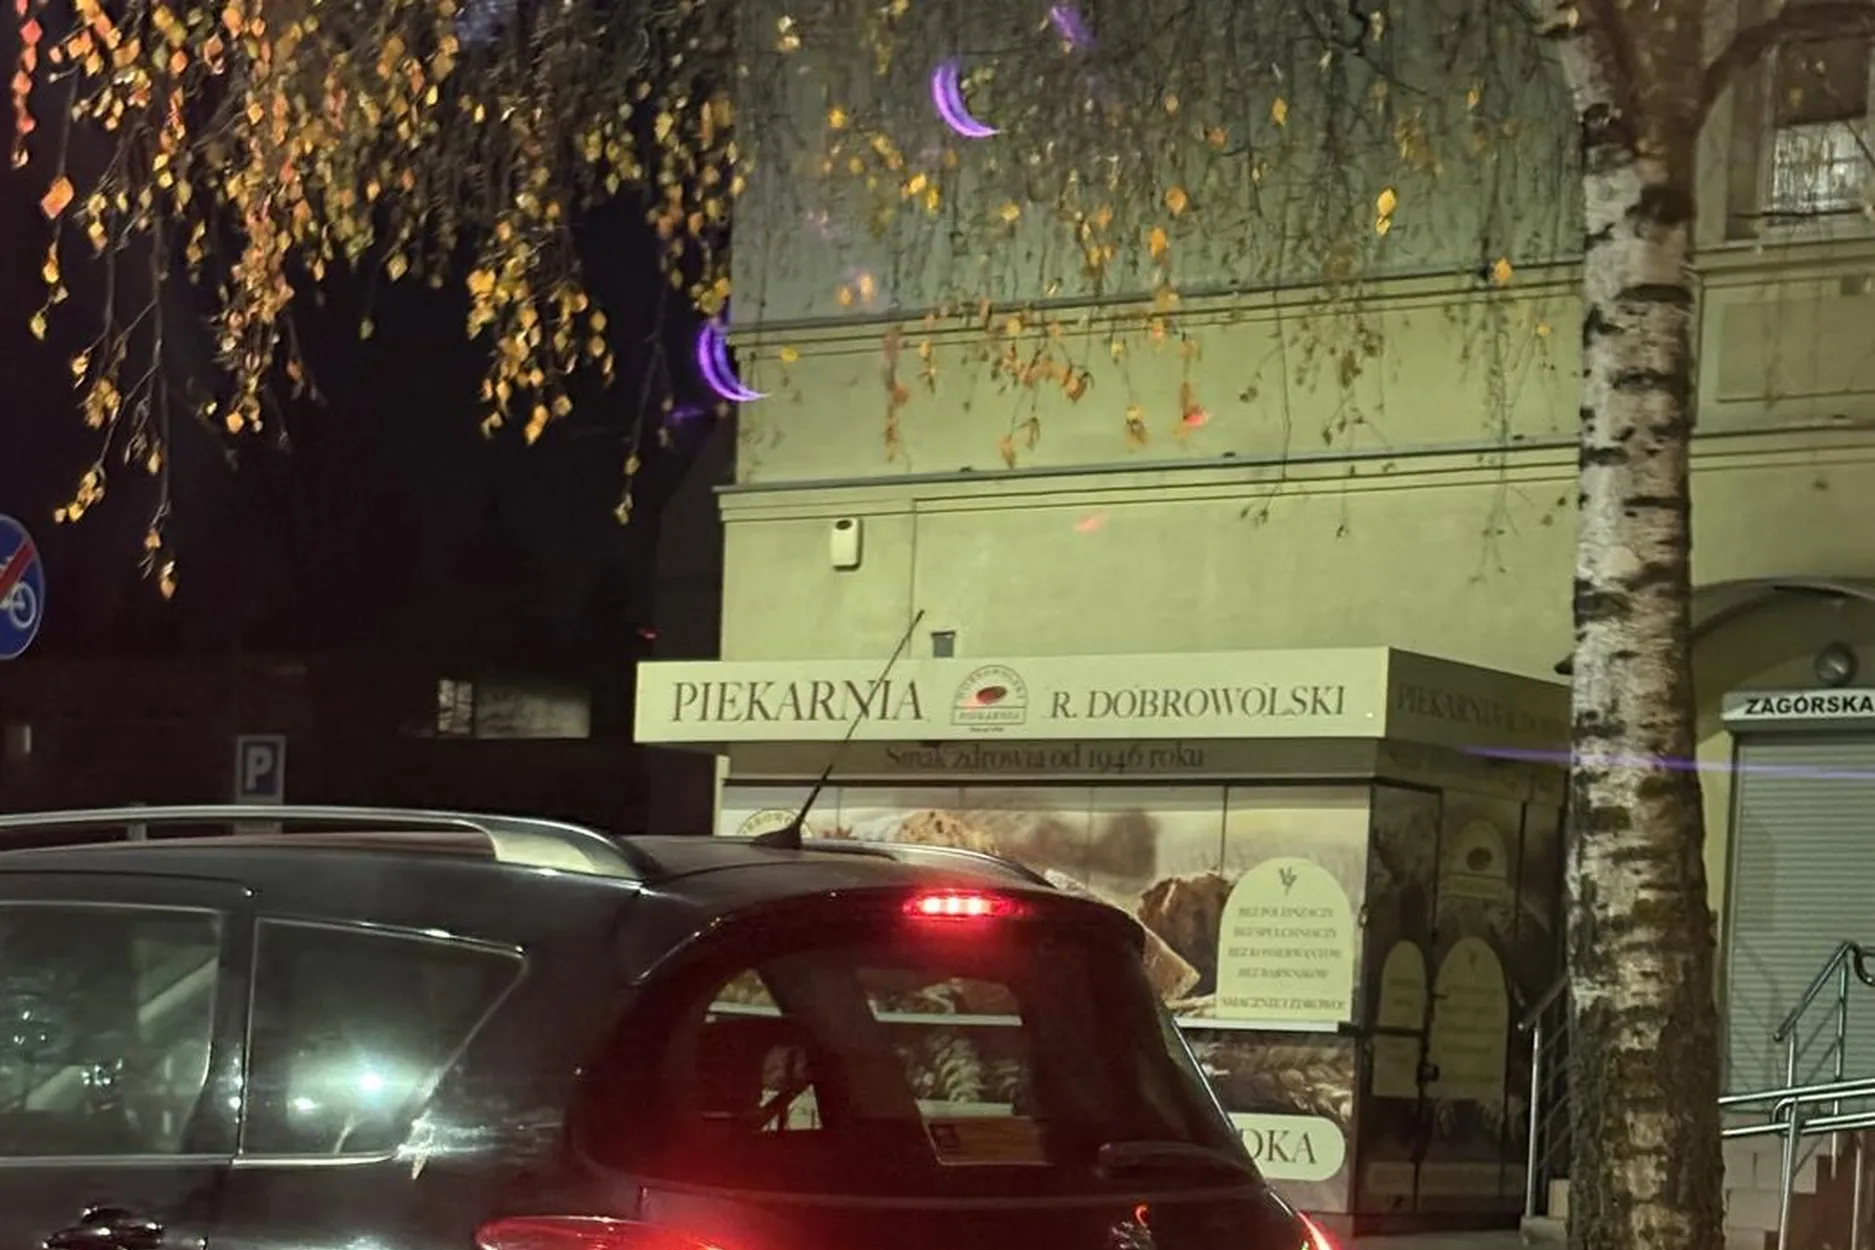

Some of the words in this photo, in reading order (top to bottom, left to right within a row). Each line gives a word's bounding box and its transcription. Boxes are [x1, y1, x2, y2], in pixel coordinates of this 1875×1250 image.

[672, 679, 924, 722] PIEKARNIA
[1050, 691, 1078, 719] R.
[1087, 685, 1346, 719] DOBROWOLSKI
[1745, 695, 1874, 714] ZAGÓRSKA
[245, 748, 272, 789] P
